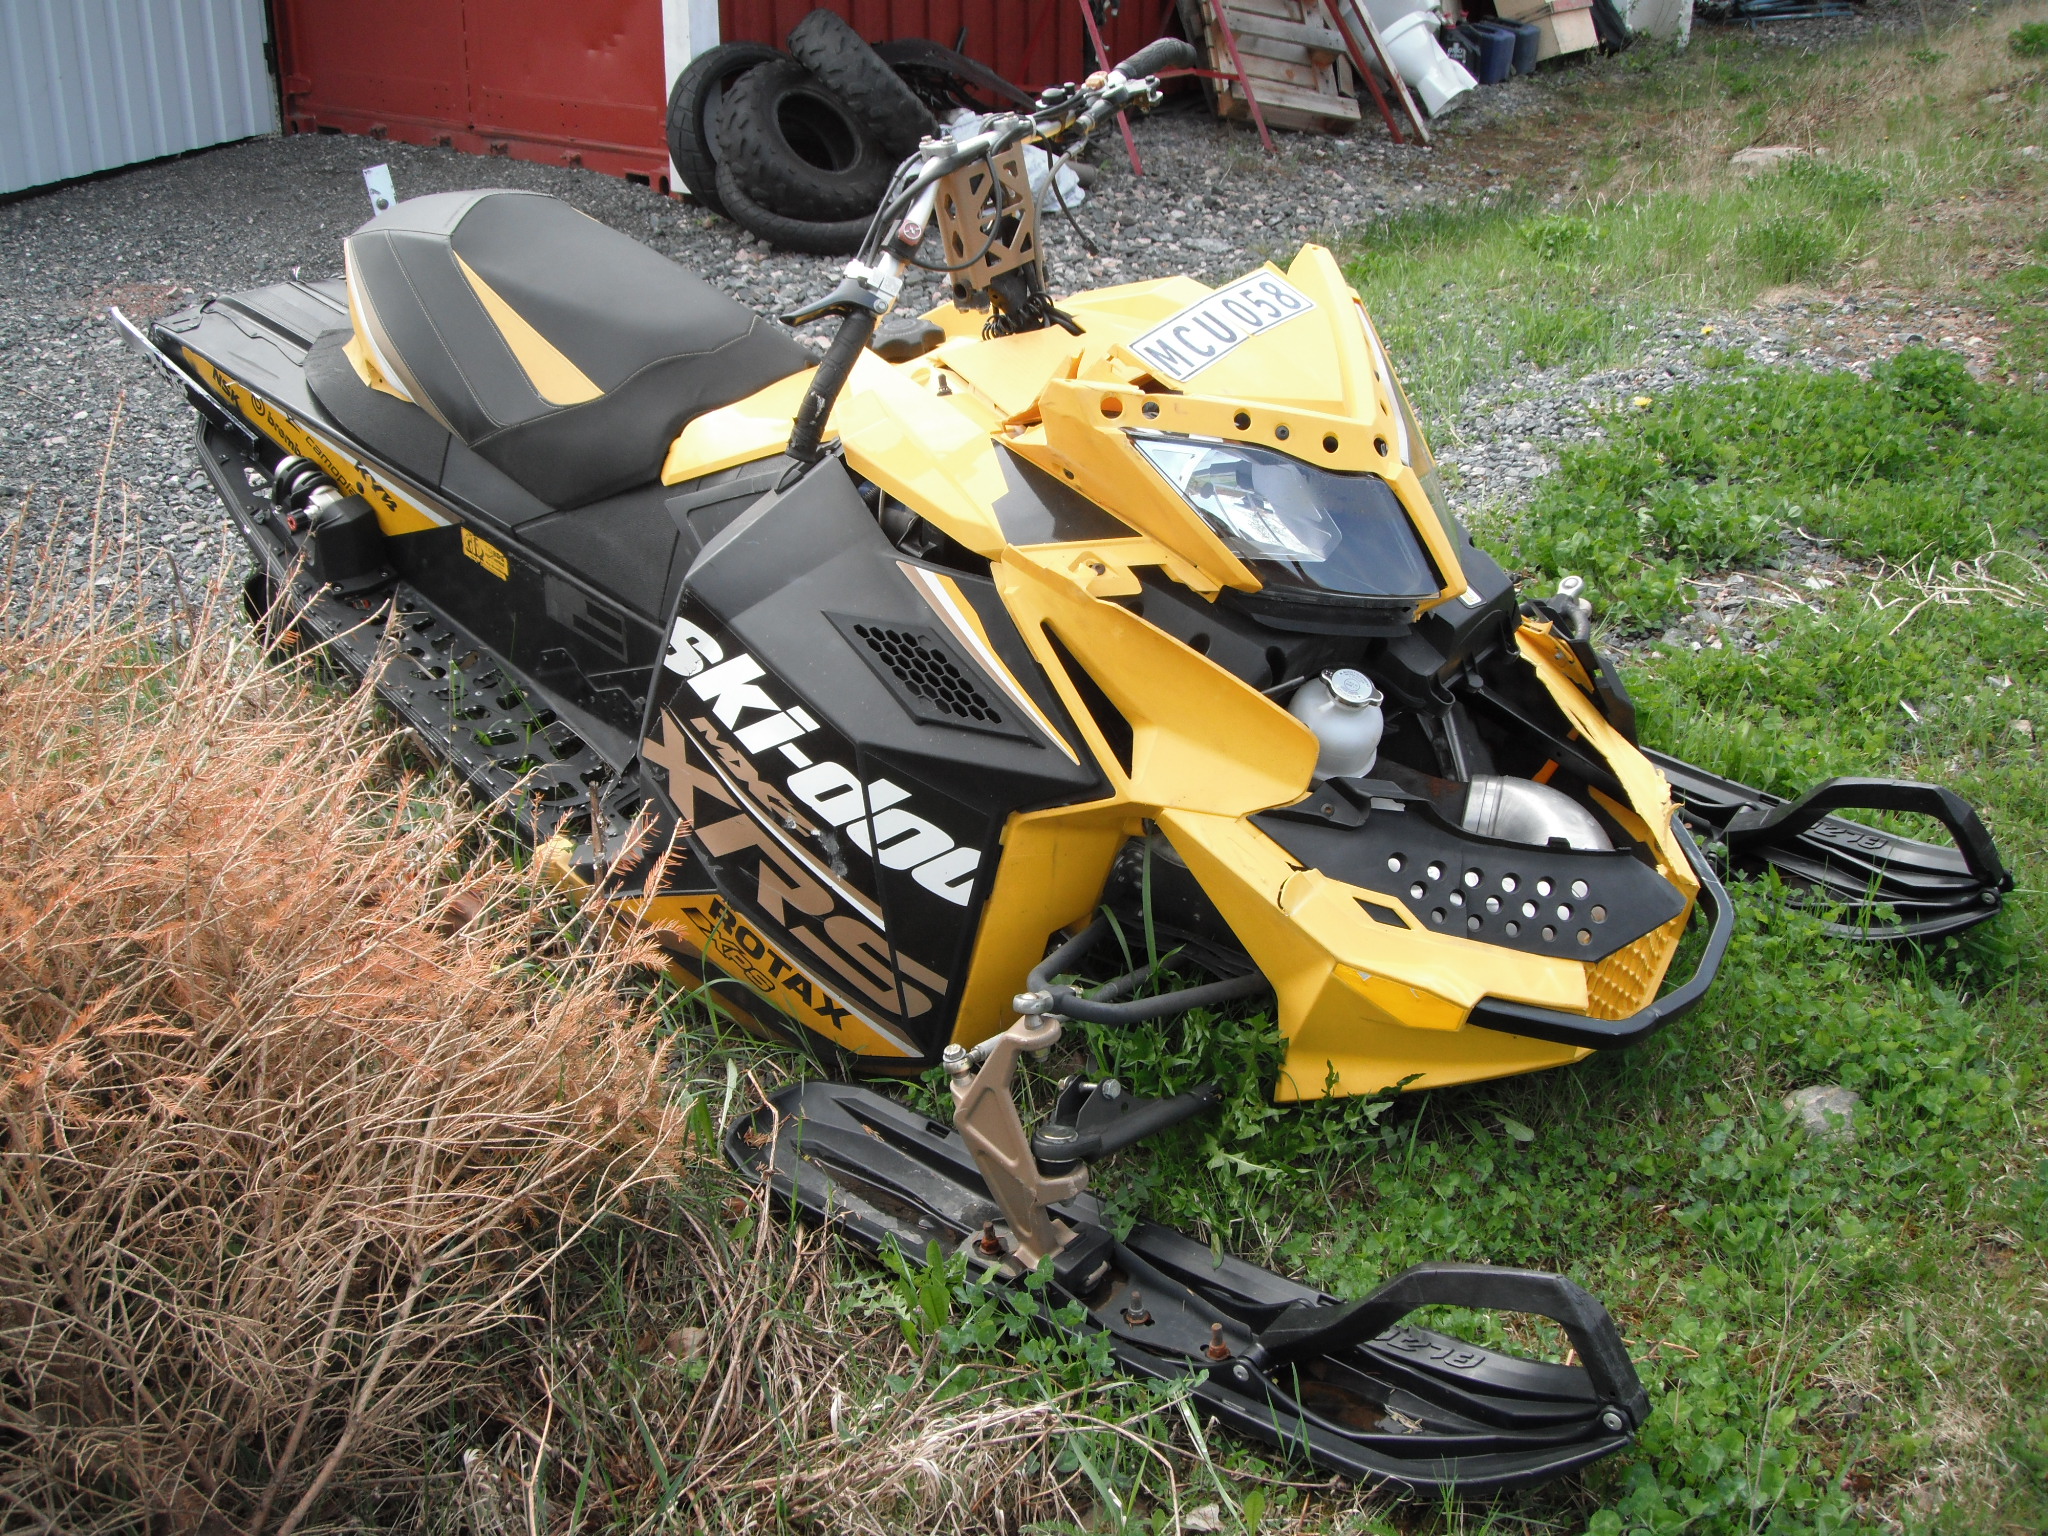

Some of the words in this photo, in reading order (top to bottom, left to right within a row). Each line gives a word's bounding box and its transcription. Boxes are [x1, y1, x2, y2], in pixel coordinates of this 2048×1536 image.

[1143, 310, 1238, 376] MCU
[1221, 281, 1301, 327] 058
[267, 411, 305, 458] bremb
[305, 436, 357, 496] camopla
[641, 706, 948, 1018] XRS
[681, 907, 776, 993] XPS
[708, 897, 852, 1031] ROTAX
